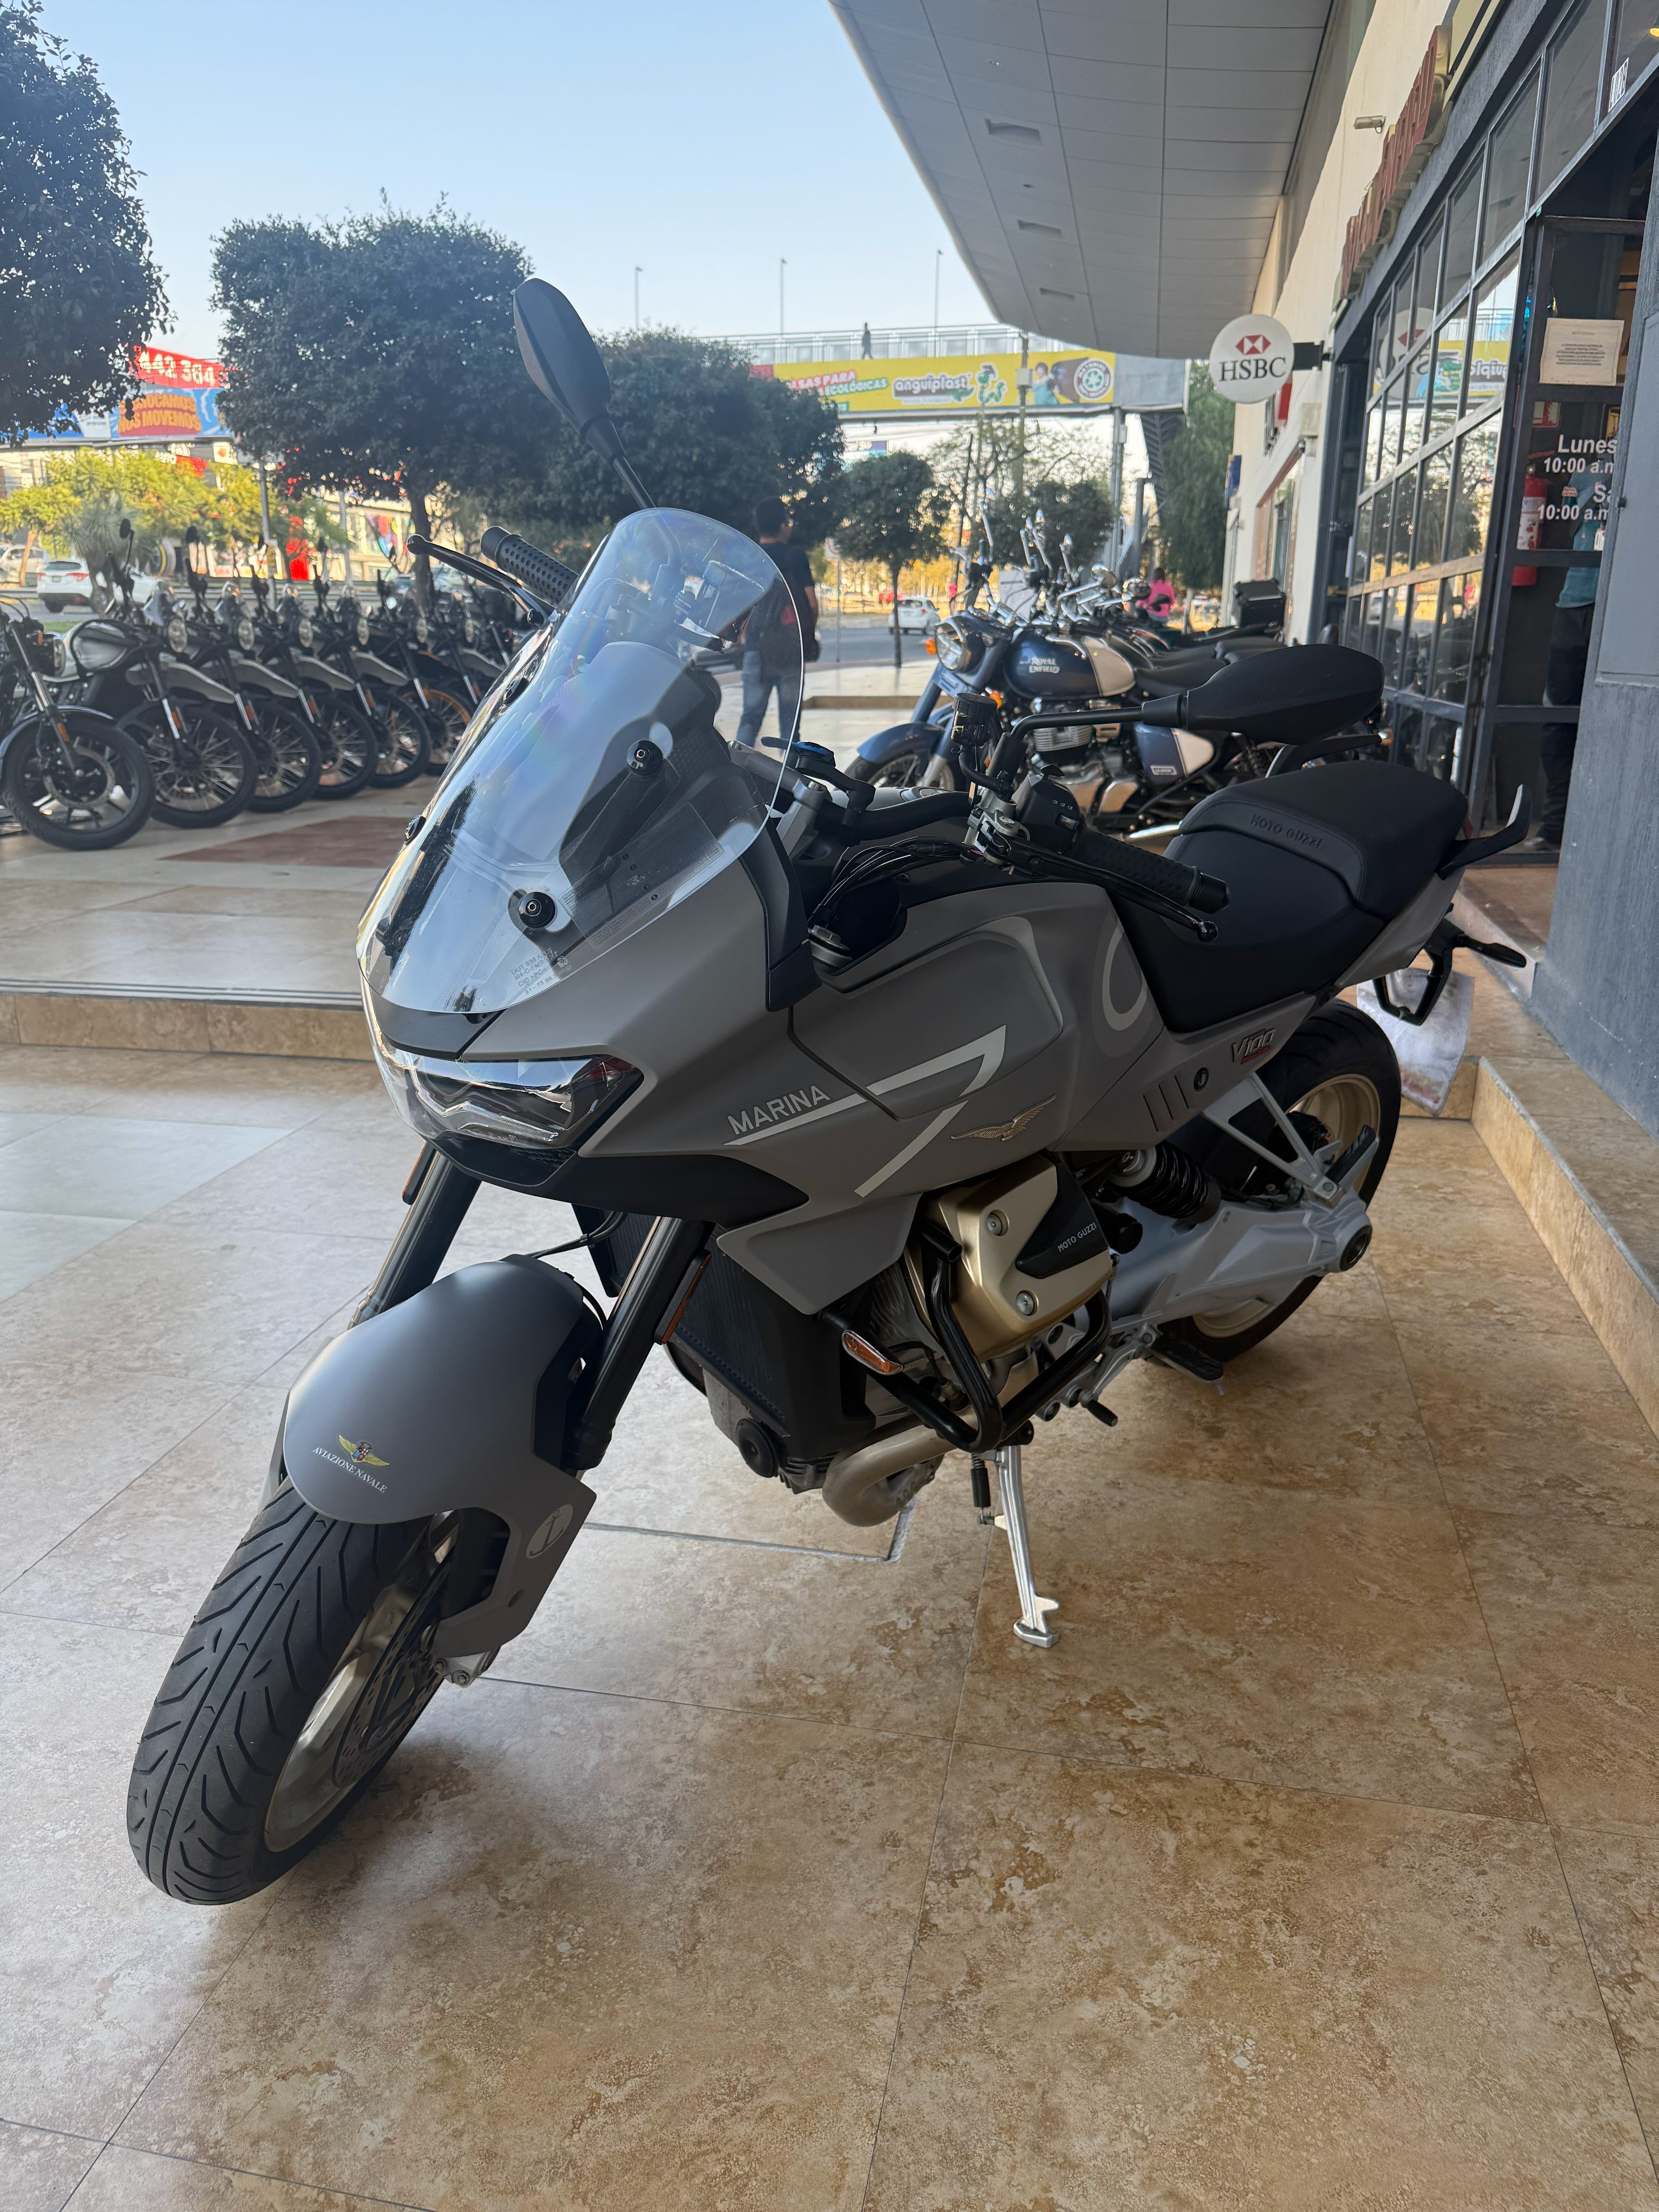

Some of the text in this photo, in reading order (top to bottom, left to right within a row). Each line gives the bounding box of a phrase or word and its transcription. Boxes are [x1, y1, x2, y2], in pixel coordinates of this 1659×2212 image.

[822, 370, 857, 385] PARA
[1219, 357, 1286, 382] HSBC
[824, 378, 887, 396] ECOLÓGICAS
[895, 374, 967, 393] anguiplast
[141, 410, 202, 432] MOVEMOS
[1558, 434, 1617, 454] Lunes
[1544, 457, 1586, 473] 10:00
[1538, 504, 1580, 520] 10:00
[1029, 665, 1060, 674] ENFIELD
[1031, 657, 1057, 665] ROYAL
[1250, 814, 1323, 849] MOTO GUZZI
[1232, 1028, 1276, 1062] V100
[727, 1085, 831, 1135] MARINA
[1058, 1222, 1097, 1252] MOTO GUZZI
[313, 1447, 387, 1493] AVIAZIONE NAVALE
